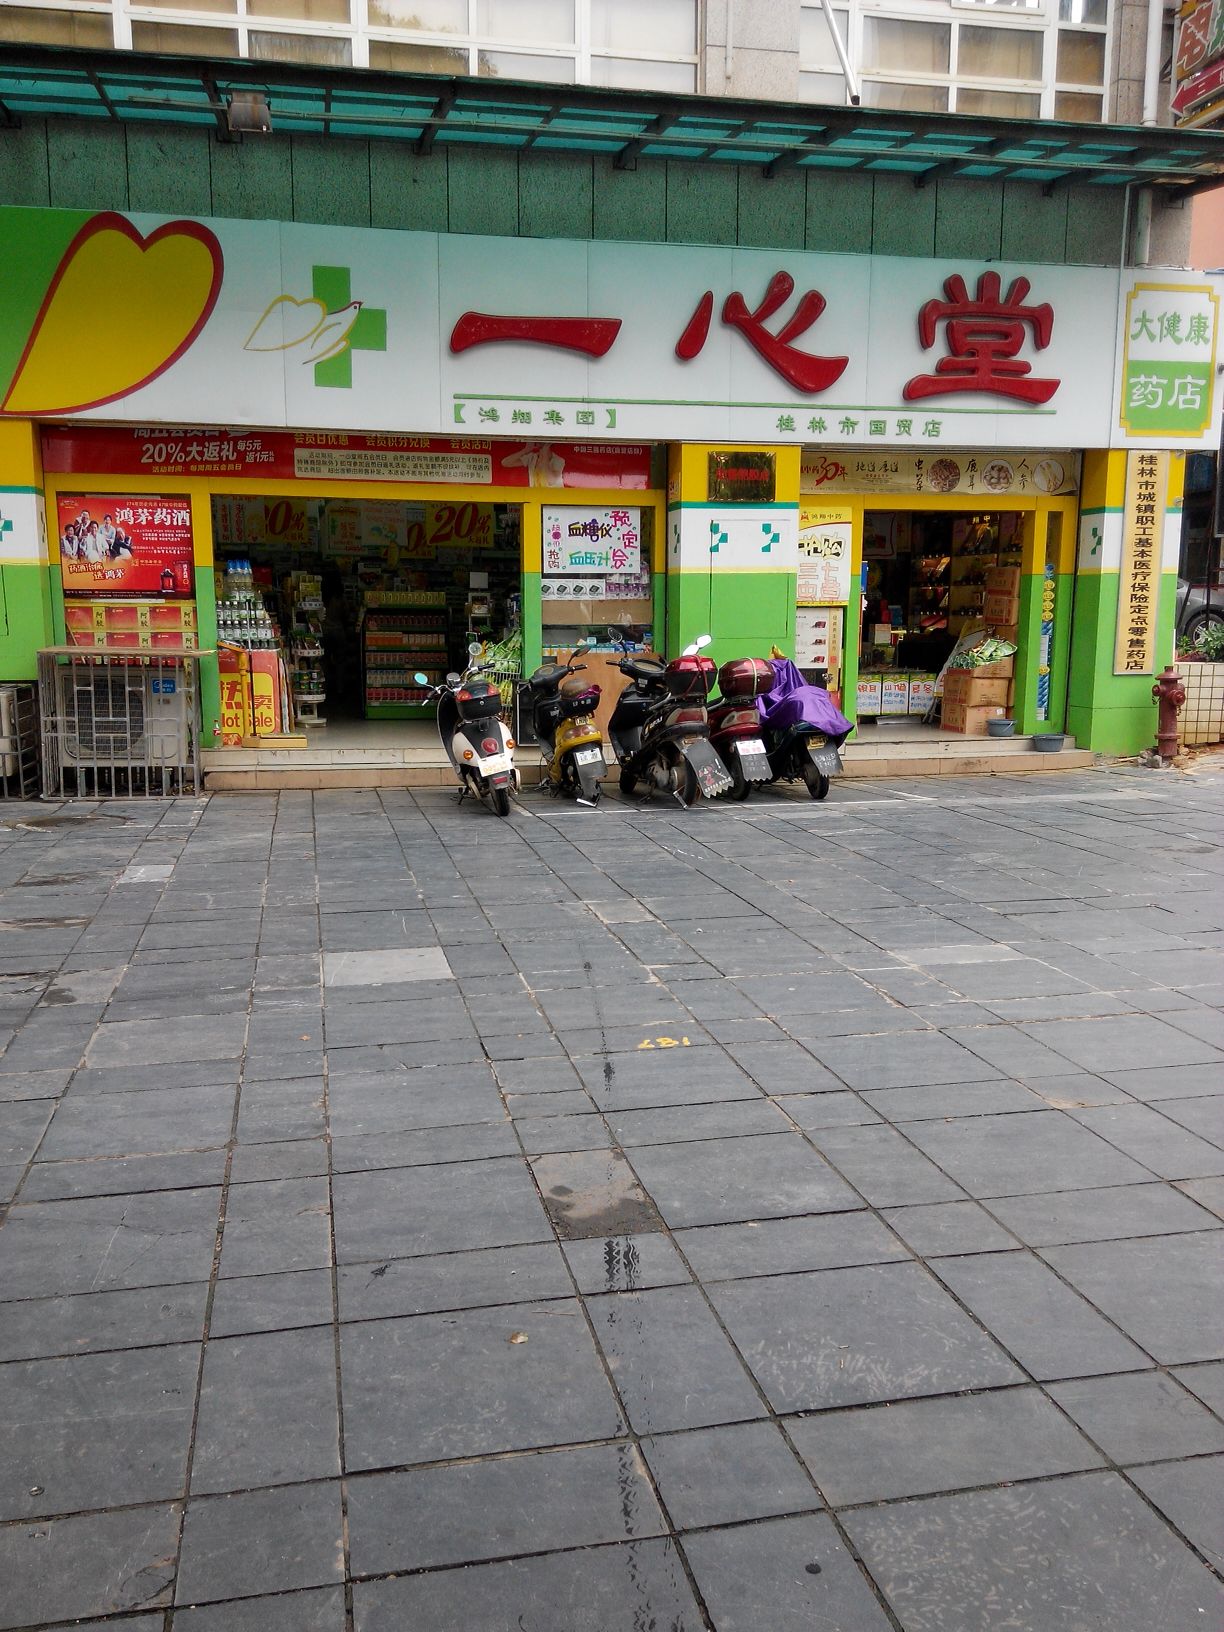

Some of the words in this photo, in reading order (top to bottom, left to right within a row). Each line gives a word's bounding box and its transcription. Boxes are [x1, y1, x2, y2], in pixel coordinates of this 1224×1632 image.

[449, 270, 1061, 405] 一心堂
[1131, 309, 1211, 347] 大健康
[1129, 374, 1207, 410] 药店
[776, 413, 943, 438] 桂林市国贸店
[140, 440, 237, 463] 20%大返礼
[115, 507, 190, 526] 鸿茅药酒
[1125, 454, 1158, 670] 桂林市城镇职工基本医疗保险定点零售药店
